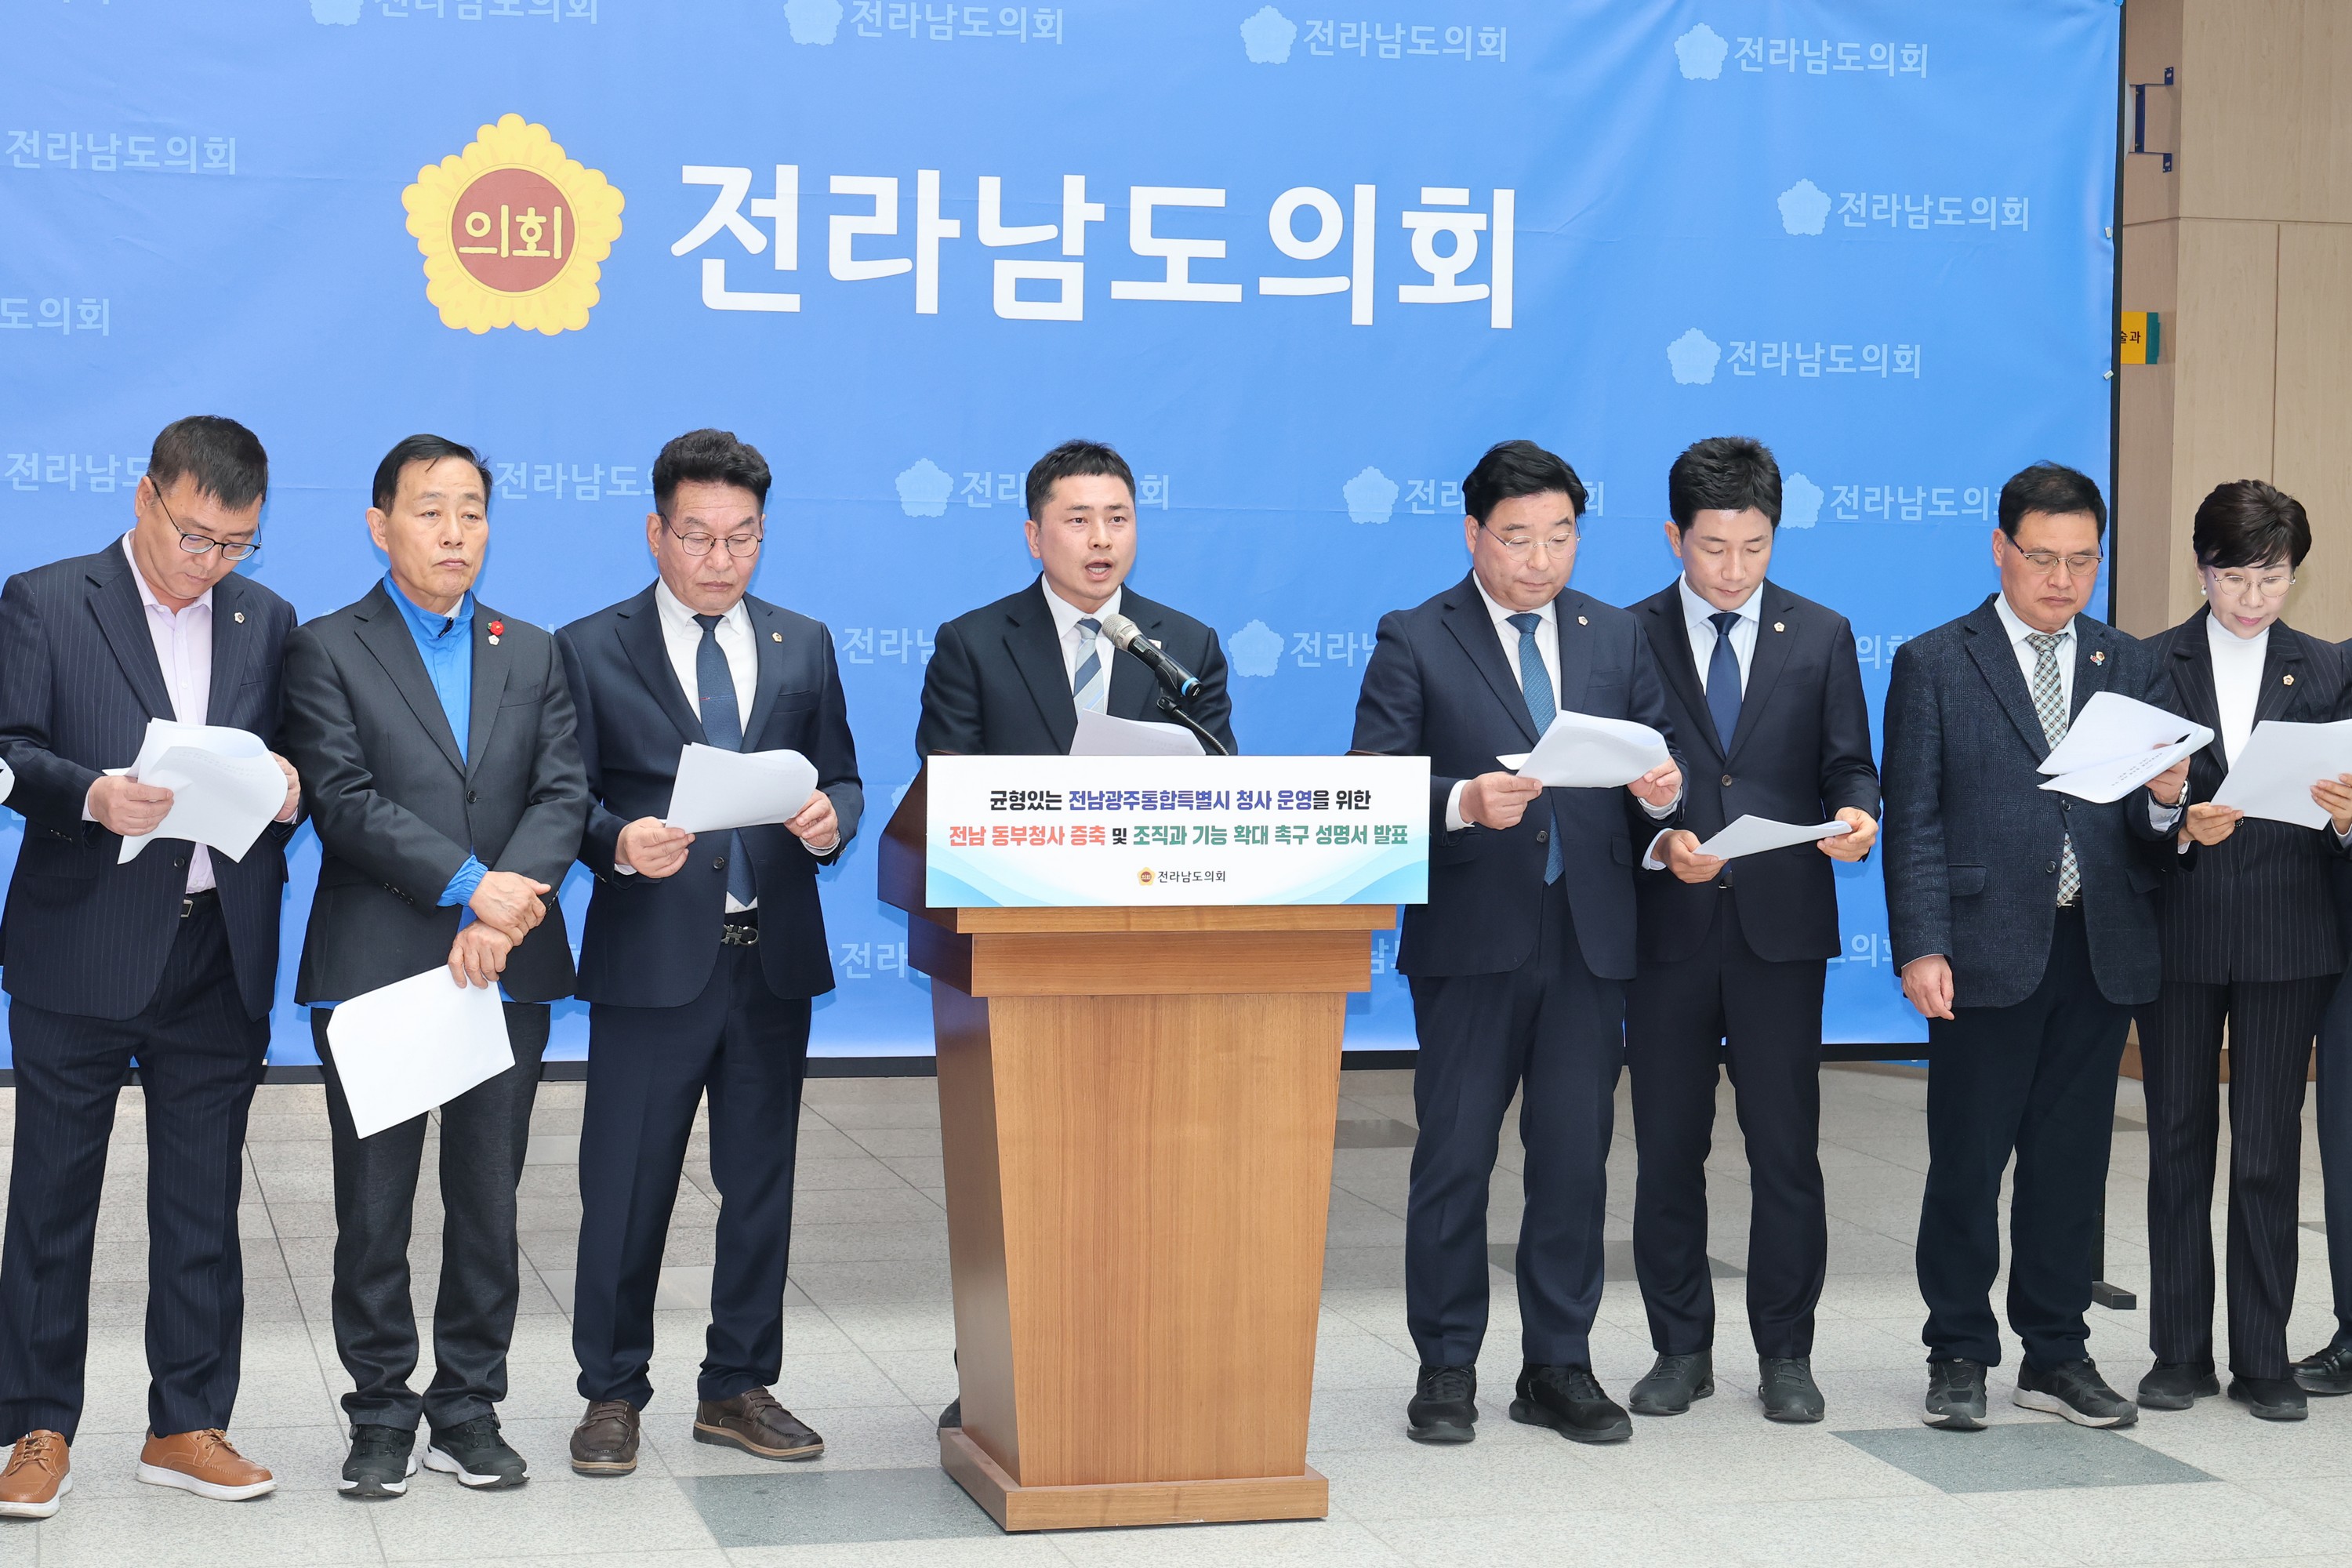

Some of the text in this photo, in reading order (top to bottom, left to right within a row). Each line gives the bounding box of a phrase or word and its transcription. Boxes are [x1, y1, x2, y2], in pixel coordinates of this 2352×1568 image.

[850, 0, 1063, 45] 전라남도의회
[1303, 18, 1507, 63] 전라남도의회
[1733, 36, 1929, 78] 전라남도의회
[5, 129, 236, 175] 전라남도의회
[459, 204, 562, 260] 의회
[1837, 191, 2030, 232] 전라남도의회
[671, 163, 1515, 329] 전라남도의회
[1726, 339, 1922, 379] 전라남도의회
[494, 462, 653, 501] 전라남도
[1830, 485, 2001, 521] 전라남도의
[990, 789, 1371, 811] 균형있는 전남광주통합특별시 청사 운영을 위한
[949, 824, 1408, 847] 전남 동부청사 증축 및 조직과 기능 확대 촉구 성명서 발표
[1157, 870, 1225, 883] 전라남도의회
